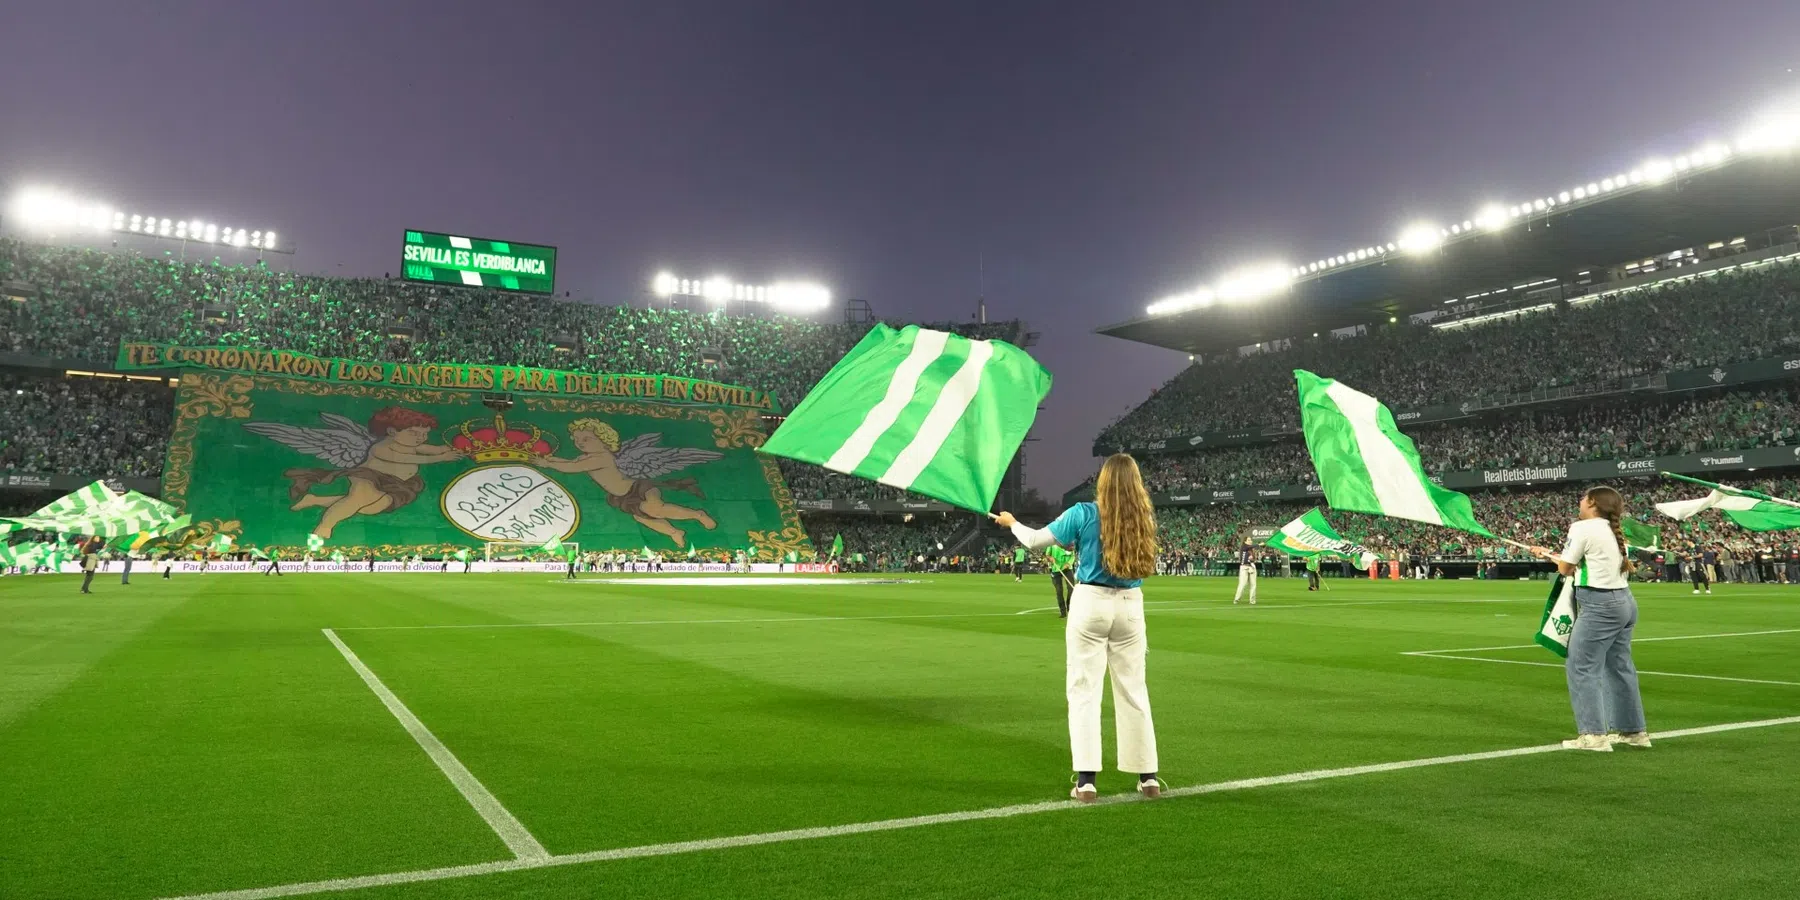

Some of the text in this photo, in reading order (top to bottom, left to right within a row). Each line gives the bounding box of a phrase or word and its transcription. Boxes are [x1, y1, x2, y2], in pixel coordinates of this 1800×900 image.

[404, 244, 545, 275] SEVILLA ES VERDIBLANCA
[124, 343, 773, 409] TE CORONARON LOS ANGELES PARA DEJARTE EN SEVILLA
[1628, 460, 1655, 468] GREE
[1711, 455, 1743, 465] hummel
[1484, 464, 1567, 482] Real Betis Balompié
[219, 562, 246, 571] salud
[313, 563, 325, 571] un
[544, 563, 563, 571] Para
